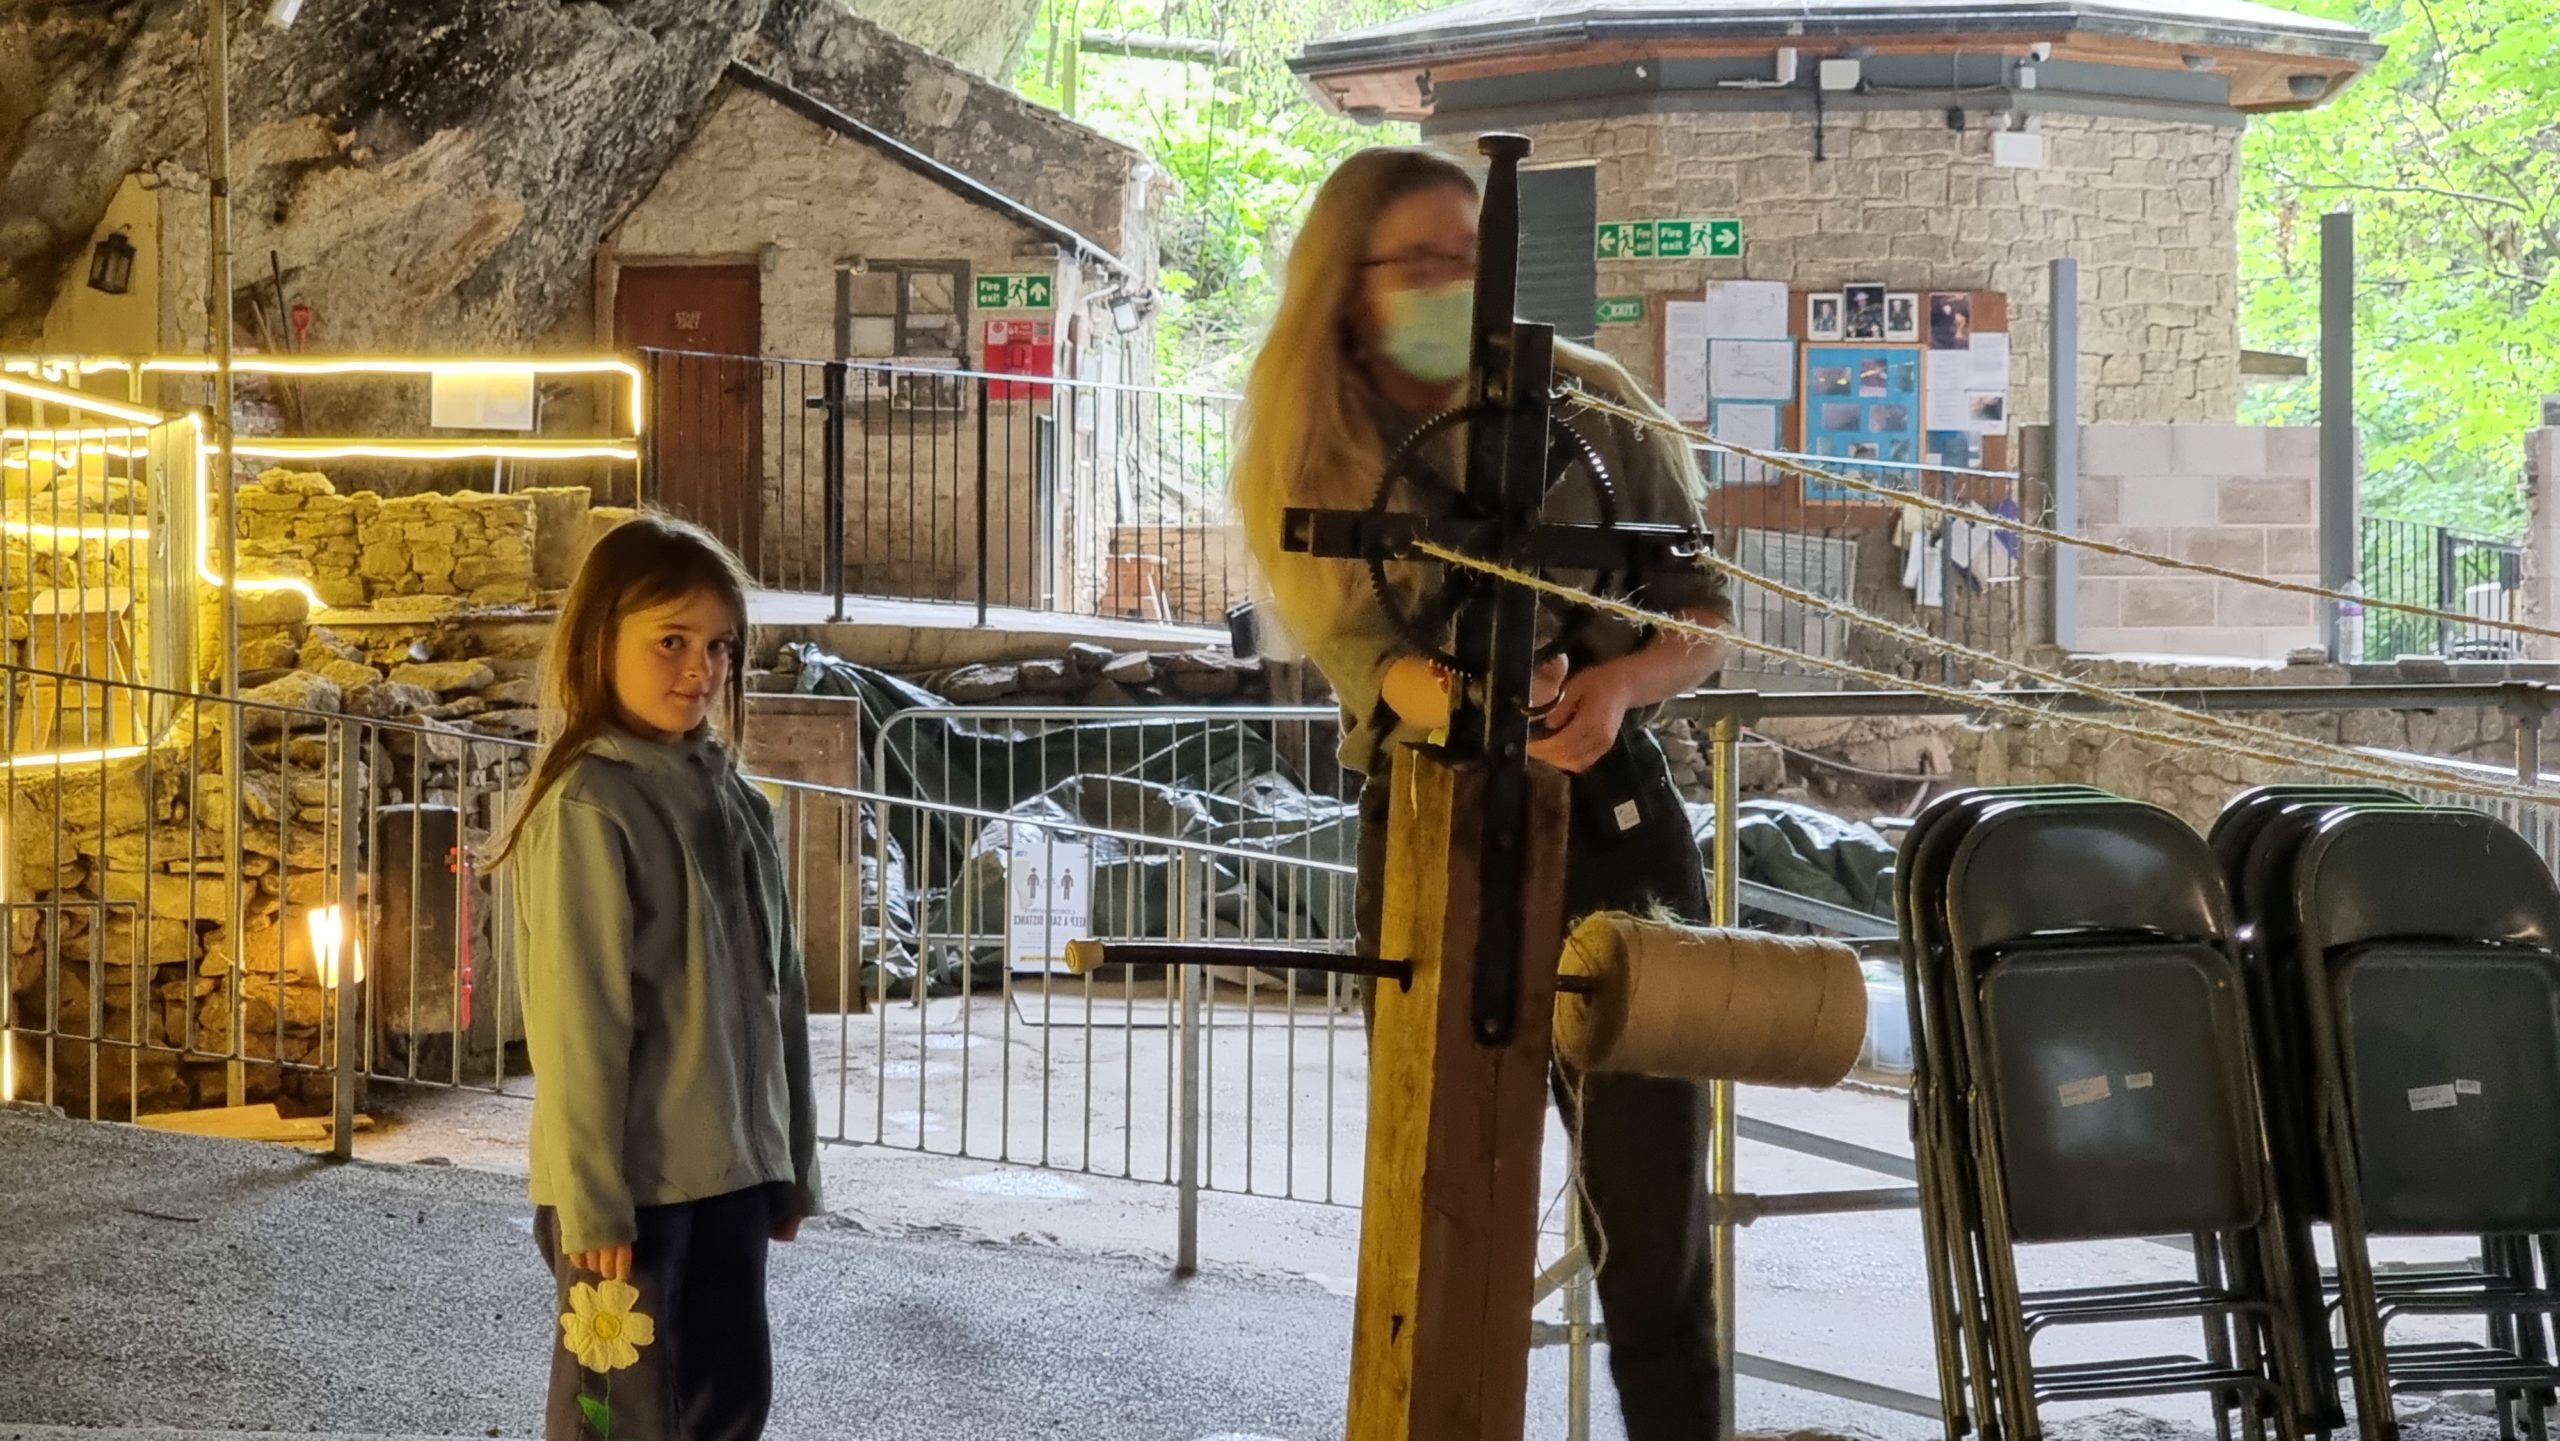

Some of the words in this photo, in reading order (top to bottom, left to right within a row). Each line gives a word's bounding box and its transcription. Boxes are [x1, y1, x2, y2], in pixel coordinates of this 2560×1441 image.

[1661, 227, 1683, 238] Fire
[1661, 241, 1683, 250] exit
[980, 281, 1000, 291] Fire
[980, 293, 1000, 303] exit
[1612, 304, 1633, 315] EXIT
